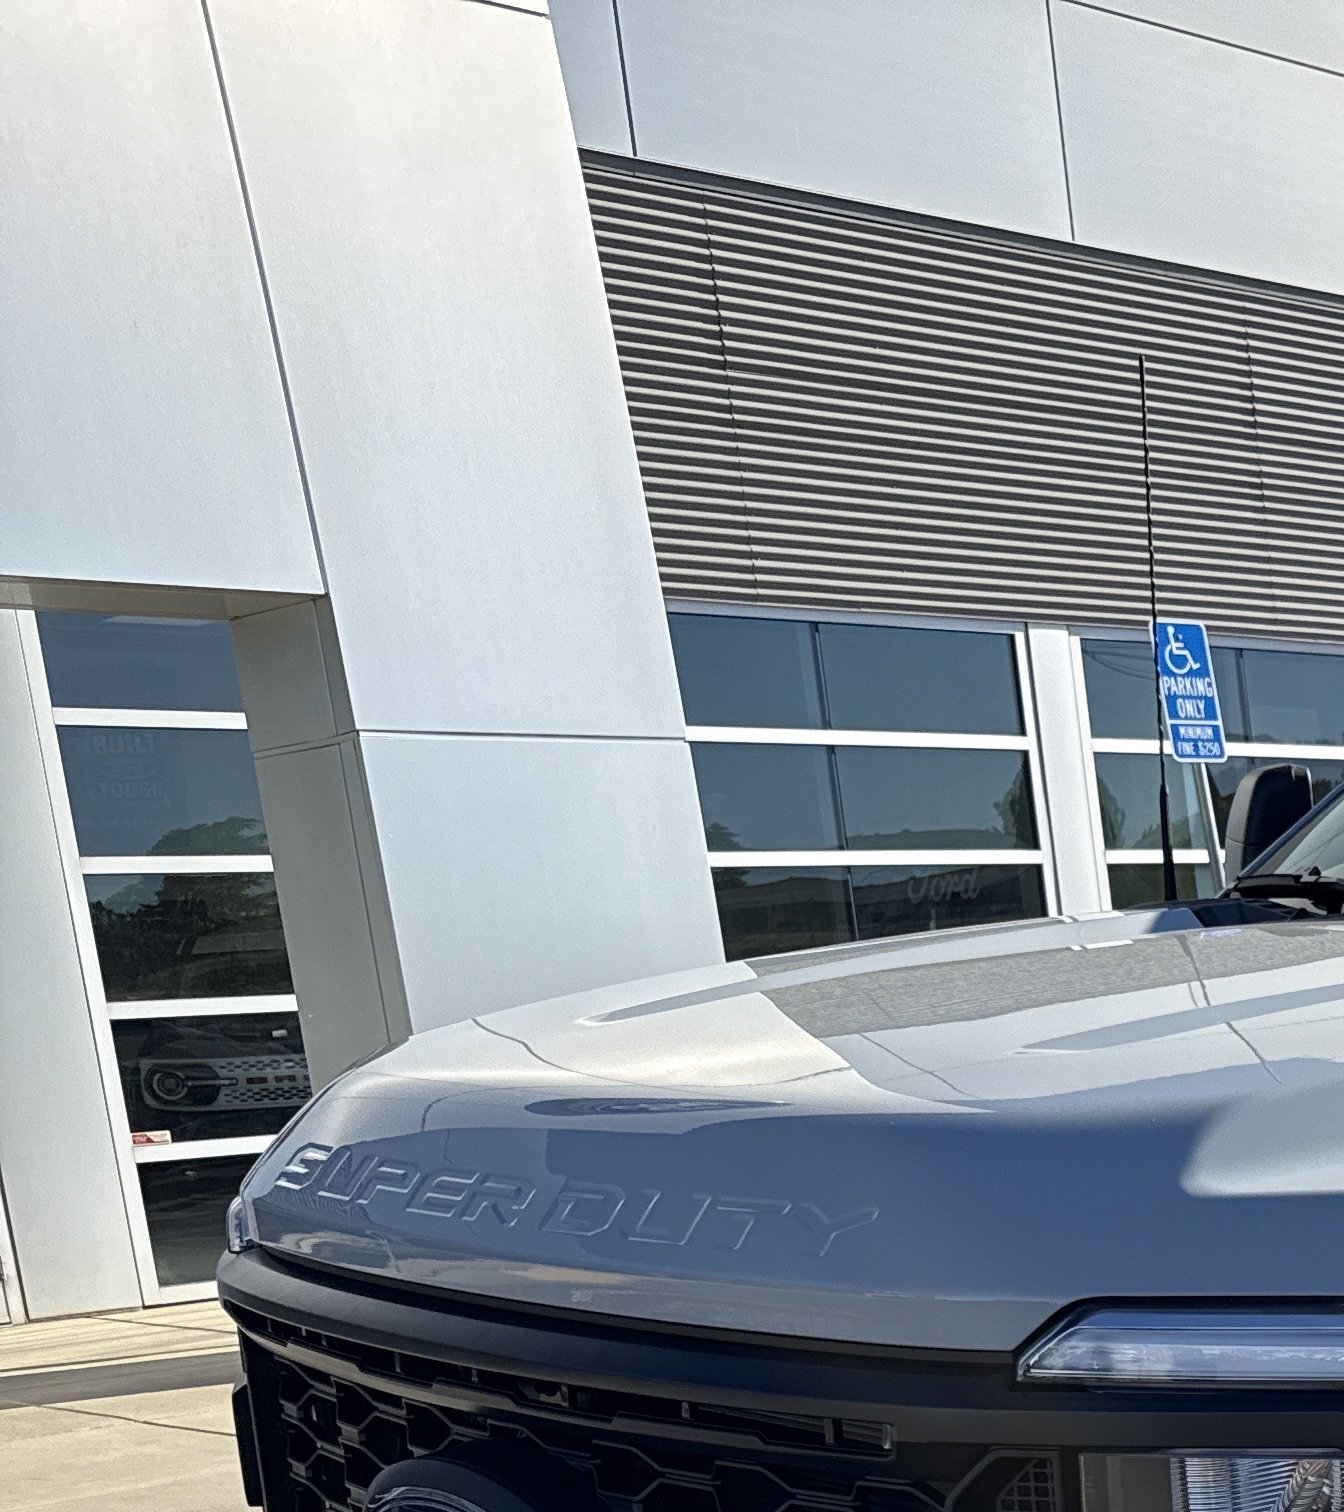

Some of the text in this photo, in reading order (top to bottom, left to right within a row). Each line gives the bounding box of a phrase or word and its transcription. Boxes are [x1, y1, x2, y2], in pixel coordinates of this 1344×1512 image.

[1162, 676, 1213, 697] PARKING
[1176, 698, 1206, 718] ONLY
[1179, 726, 1214, 739] MINIMUM
[1177, 741, 1221, 756] FINE $250
[273, 1142, 879, 1258] SUPER DUTY
